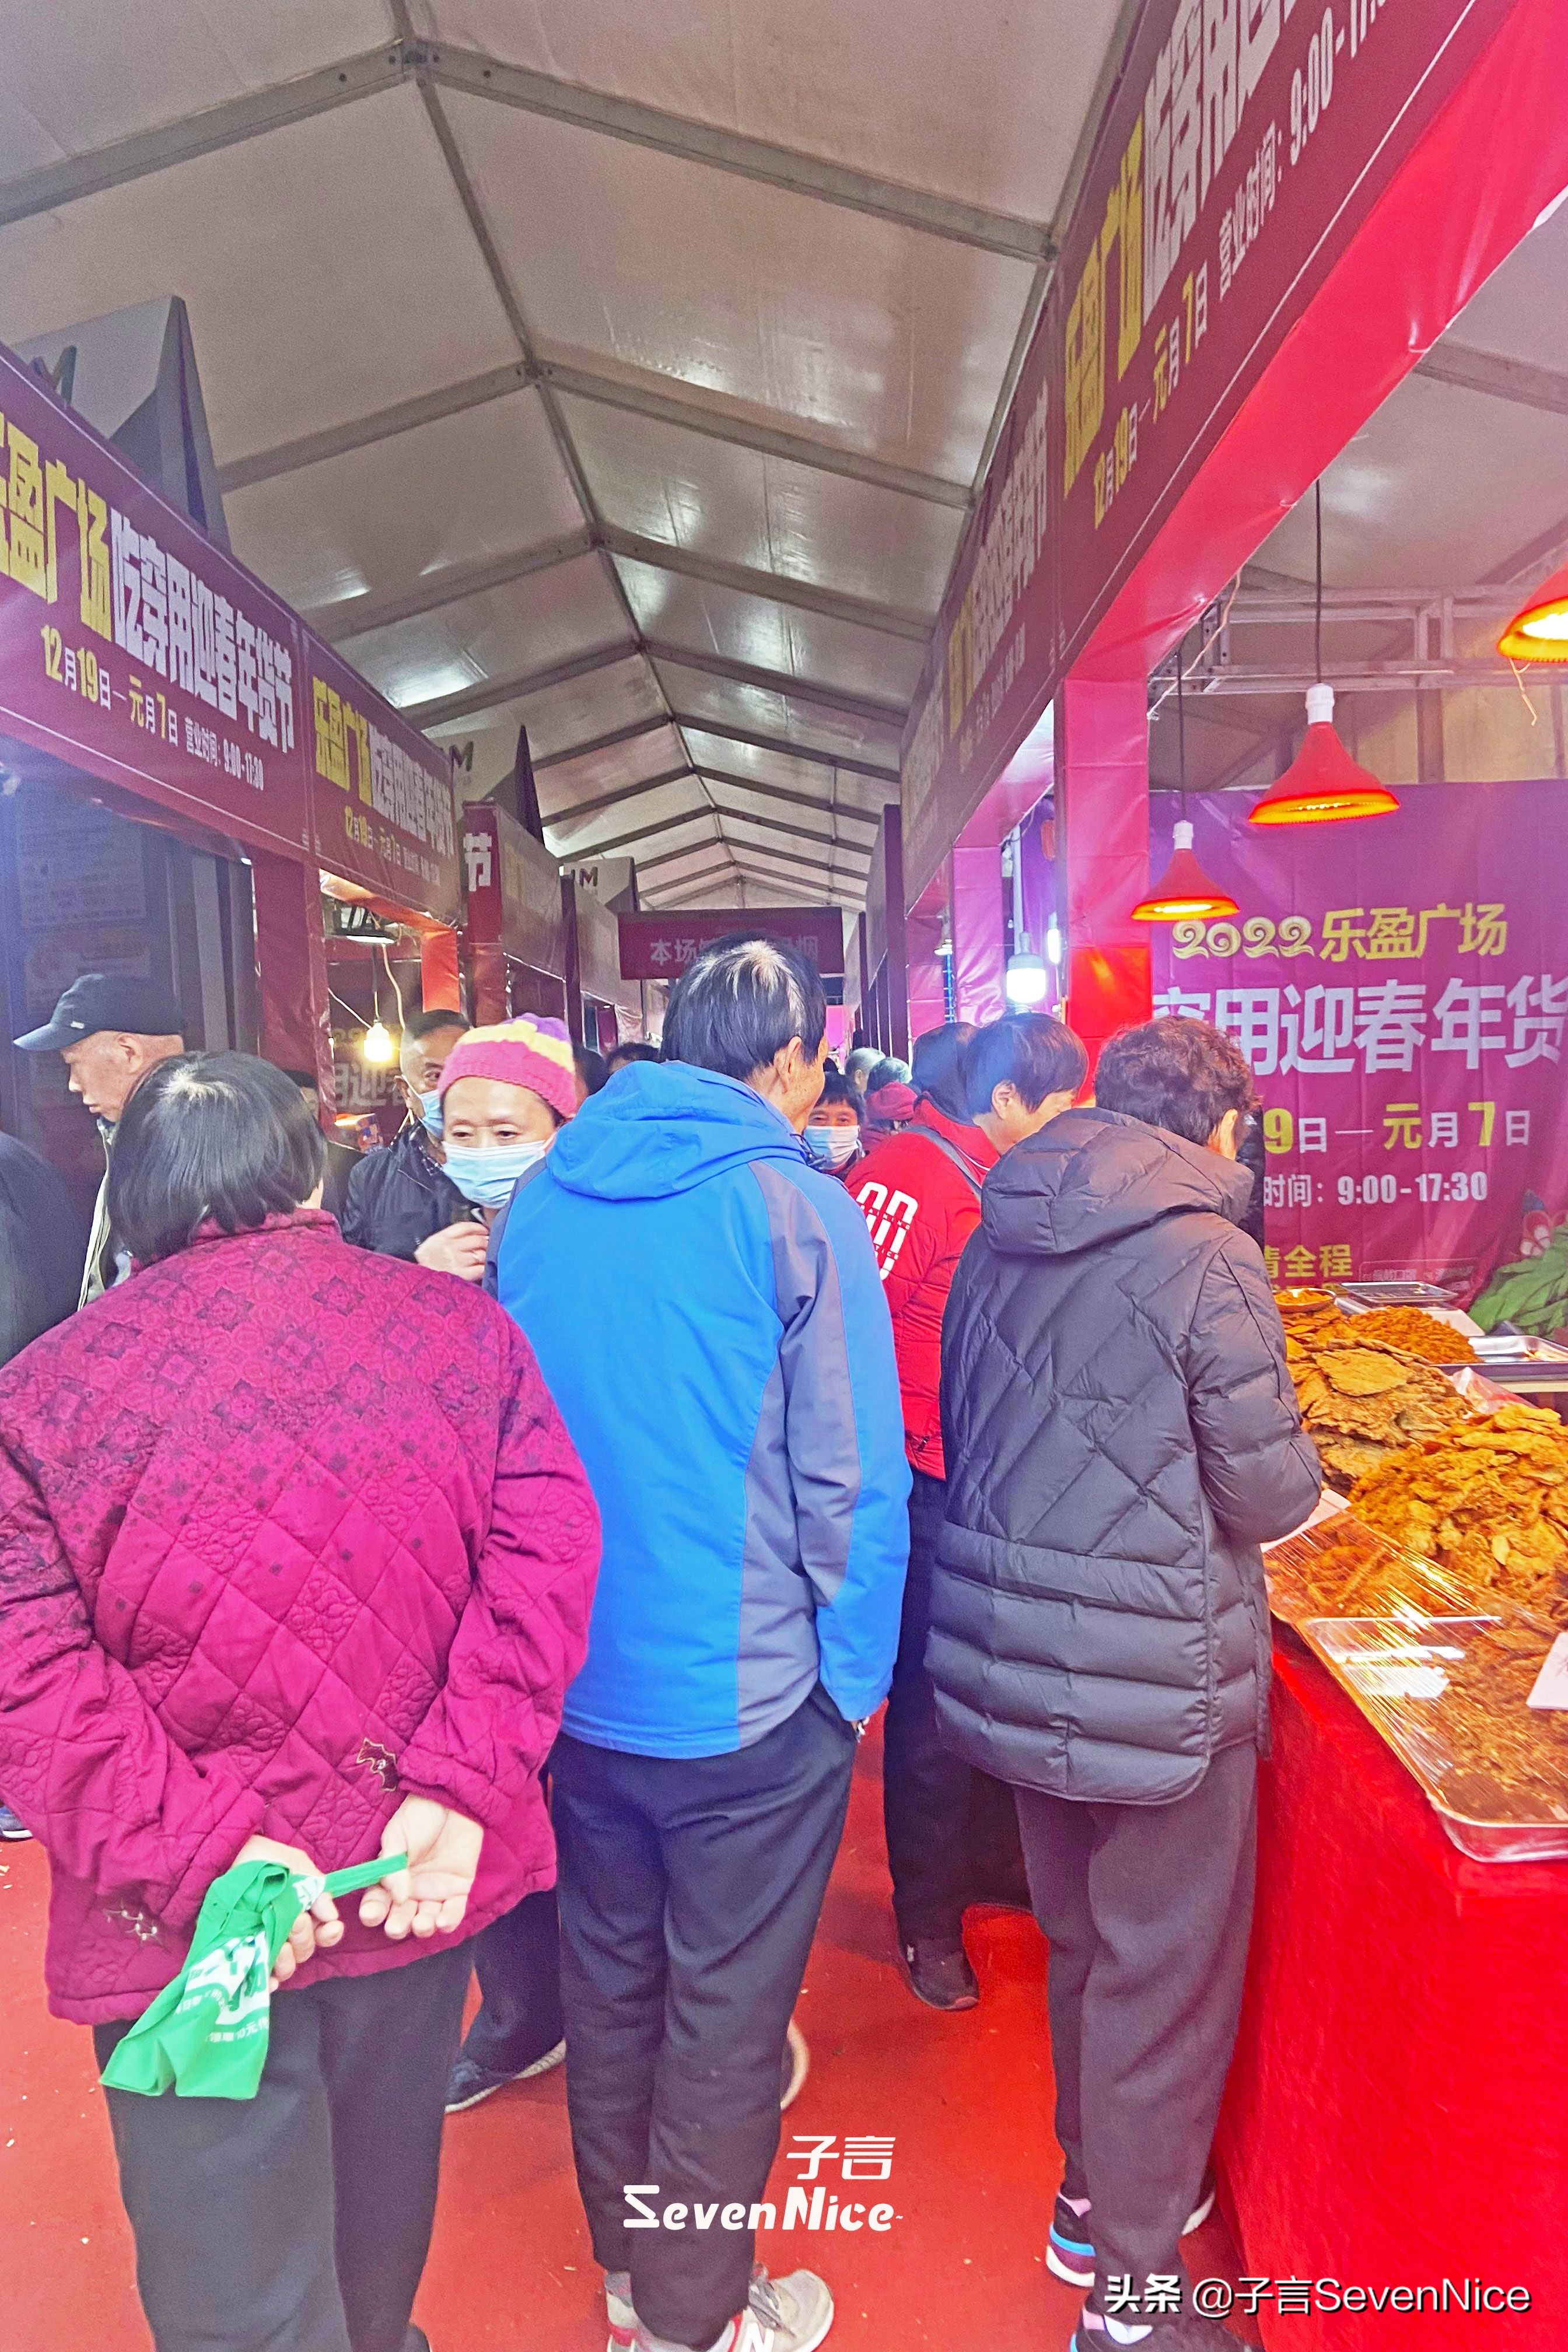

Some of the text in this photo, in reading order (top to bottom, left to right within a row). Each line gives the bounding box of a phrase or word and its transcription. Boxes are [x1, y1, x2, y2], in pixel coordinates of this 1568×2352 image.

[0, 411, 294, 752] 盈广场吃穿用迎春年货节
